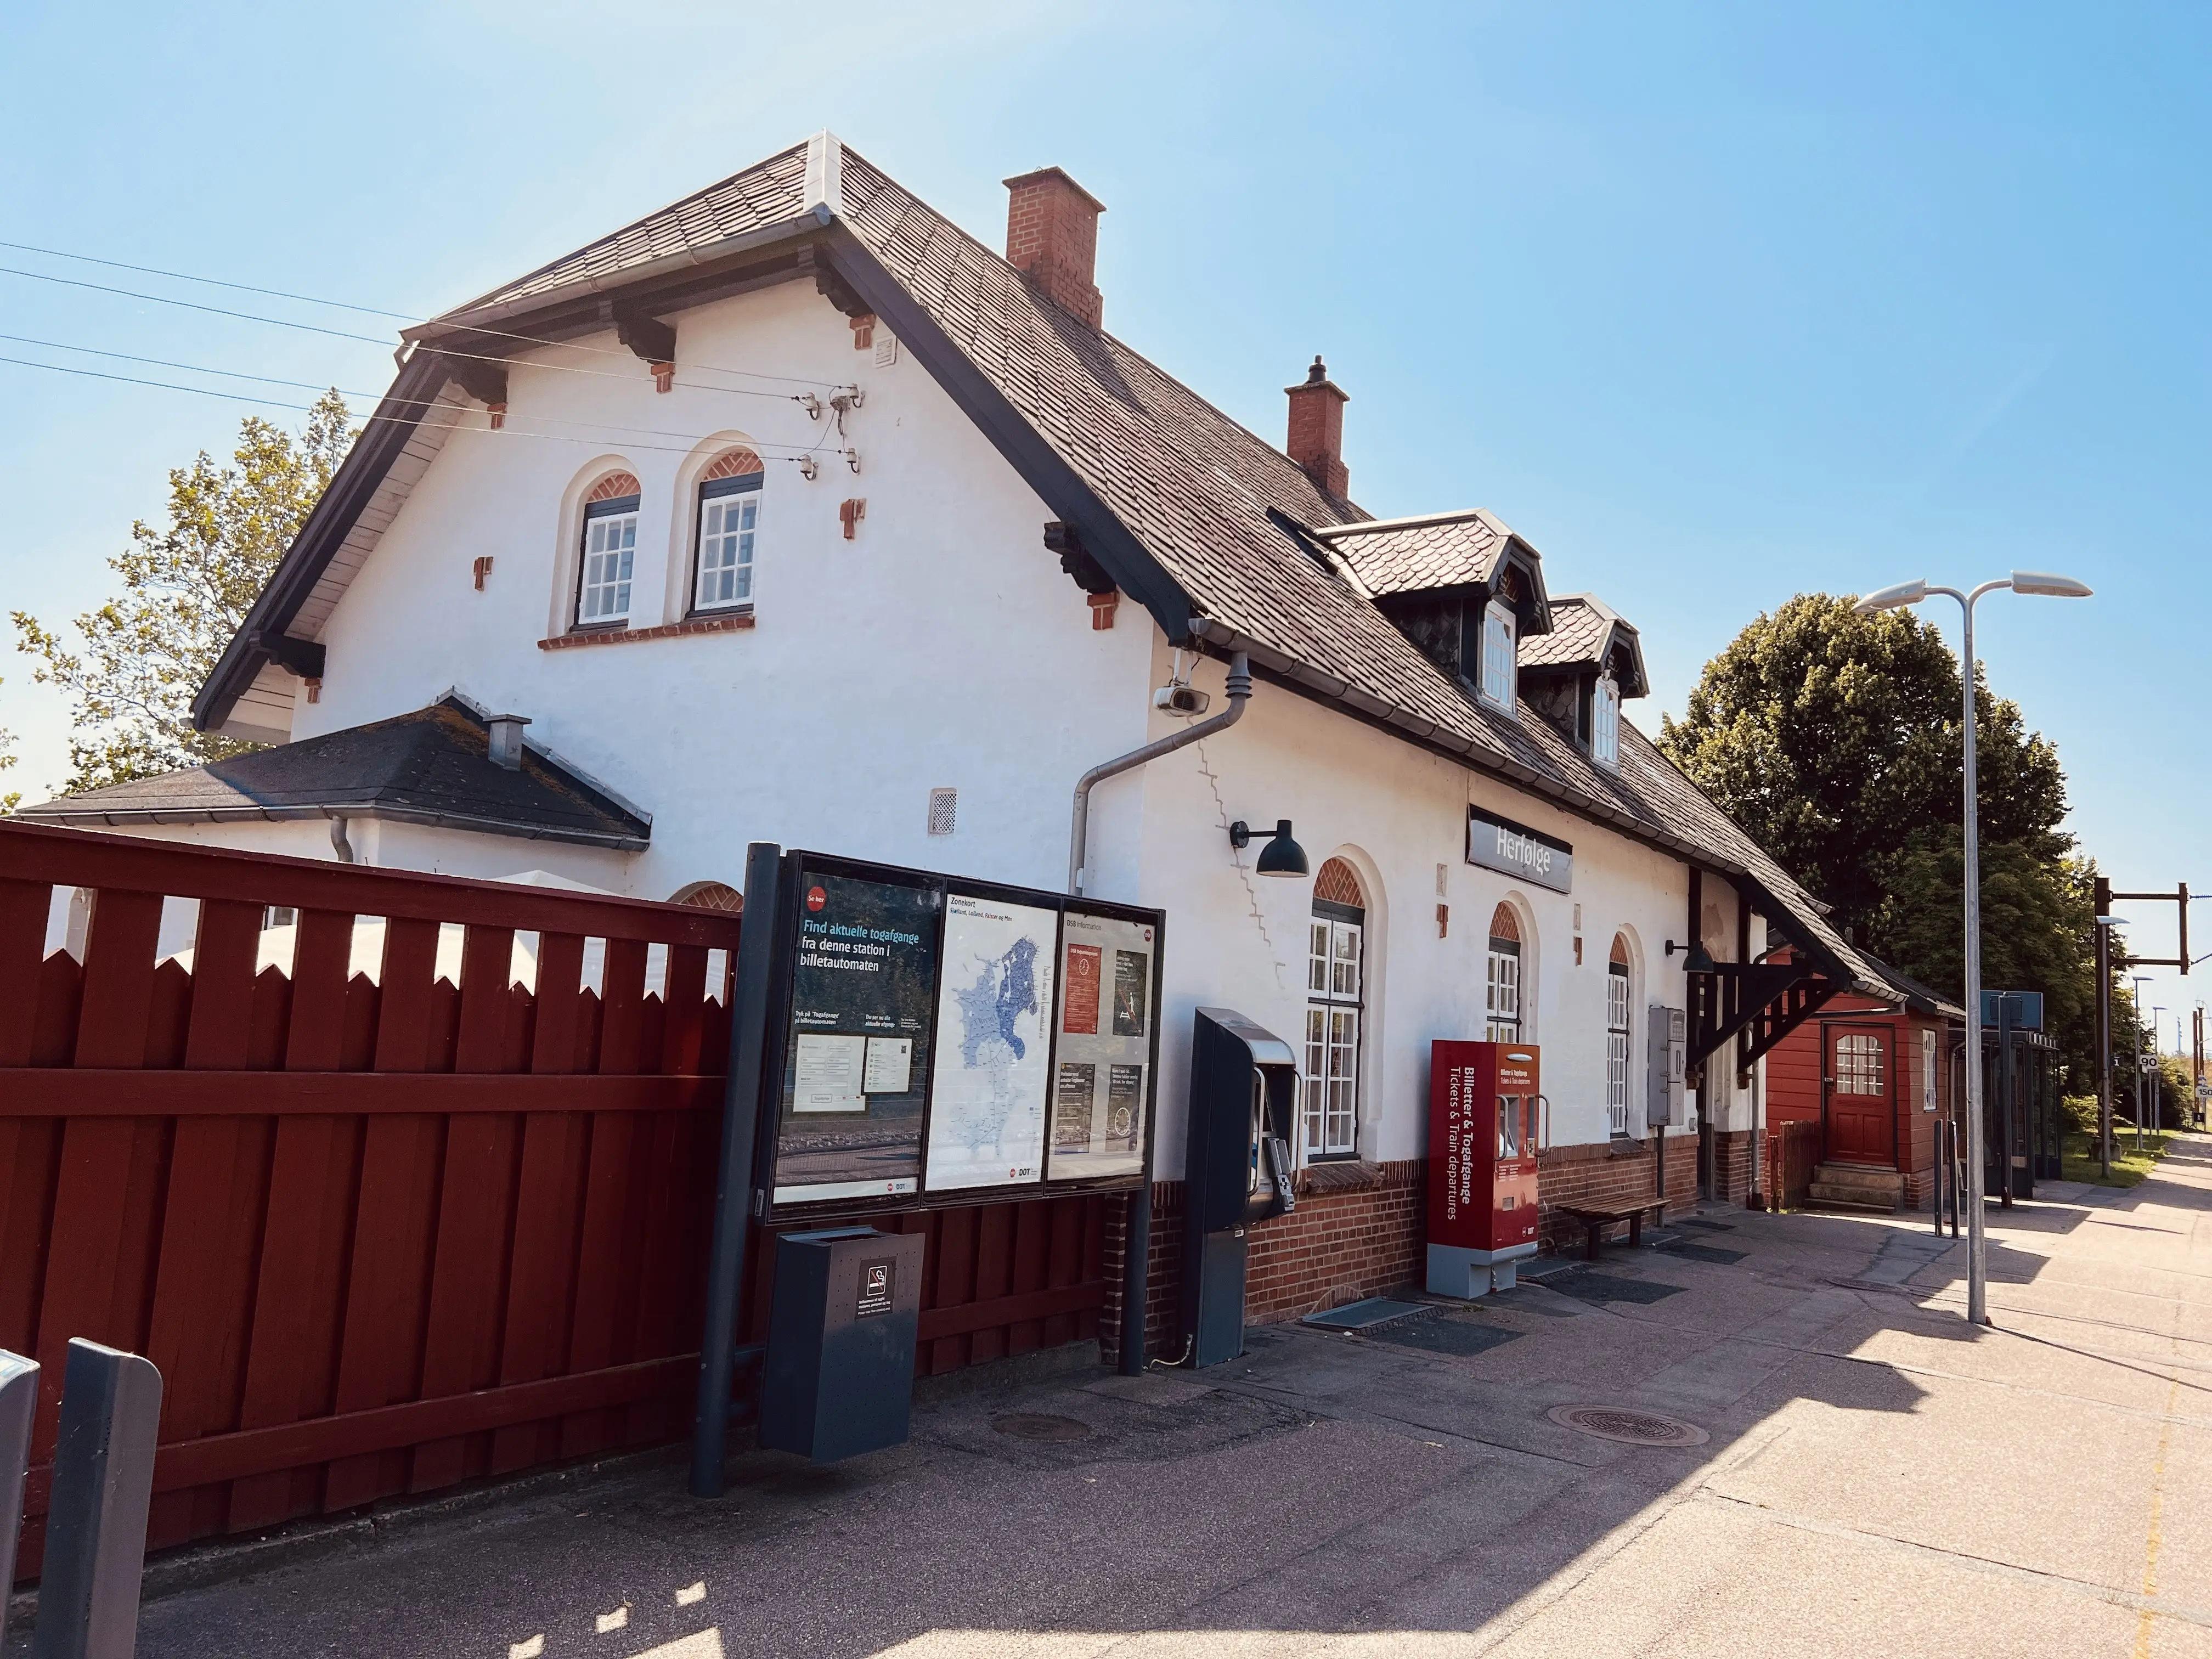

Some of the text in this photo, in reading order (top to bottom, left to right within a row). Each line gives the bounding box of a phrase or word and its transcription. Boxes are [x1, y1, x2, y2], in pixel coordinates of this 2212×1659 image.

[1497, 826, 1550, 876] Herfølge
[951, 897, 976, 907] Zonekort
[968, 910, 984, 918] Lolland,
[804, 919, 919, 945] Find aktuelle togafgange
[1077, 922, 1102, 930] Information
[802, 936, 890, 957] fra denne station i
[800, 953, 879, 972] billetautomaten
[2141, 1058, 2157, 1066] 90
[1446, 1066, 1461, 1220] Tickets & Train departures
[1460, 1067, 1475, 1204] Billetter & Togafgange
